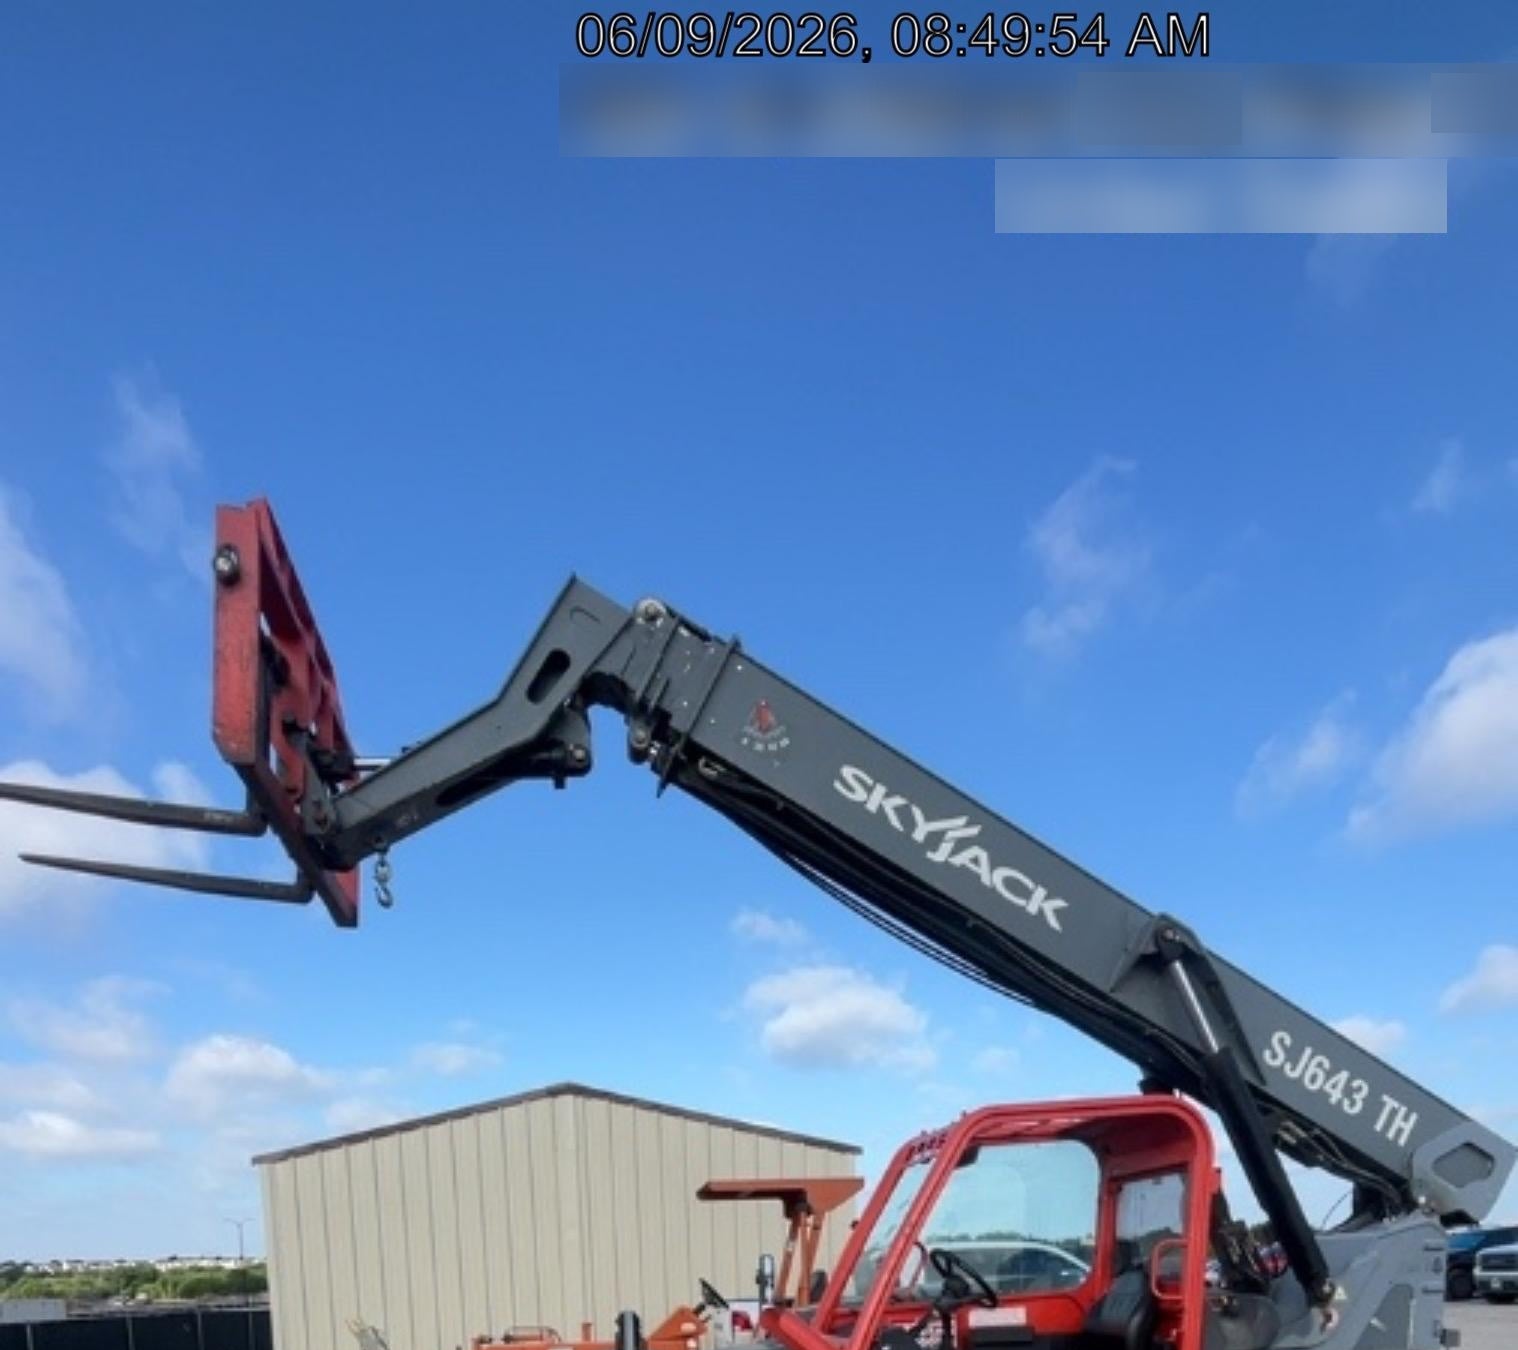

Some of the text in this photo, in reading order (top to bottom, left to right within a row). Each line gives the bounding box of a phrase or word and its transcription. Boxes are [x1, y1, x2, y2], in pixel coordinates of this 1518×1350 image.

[833, 764, 1069, 934] SKYJACK
[1262, 1030, 1418, 1147] SJ643 TH
